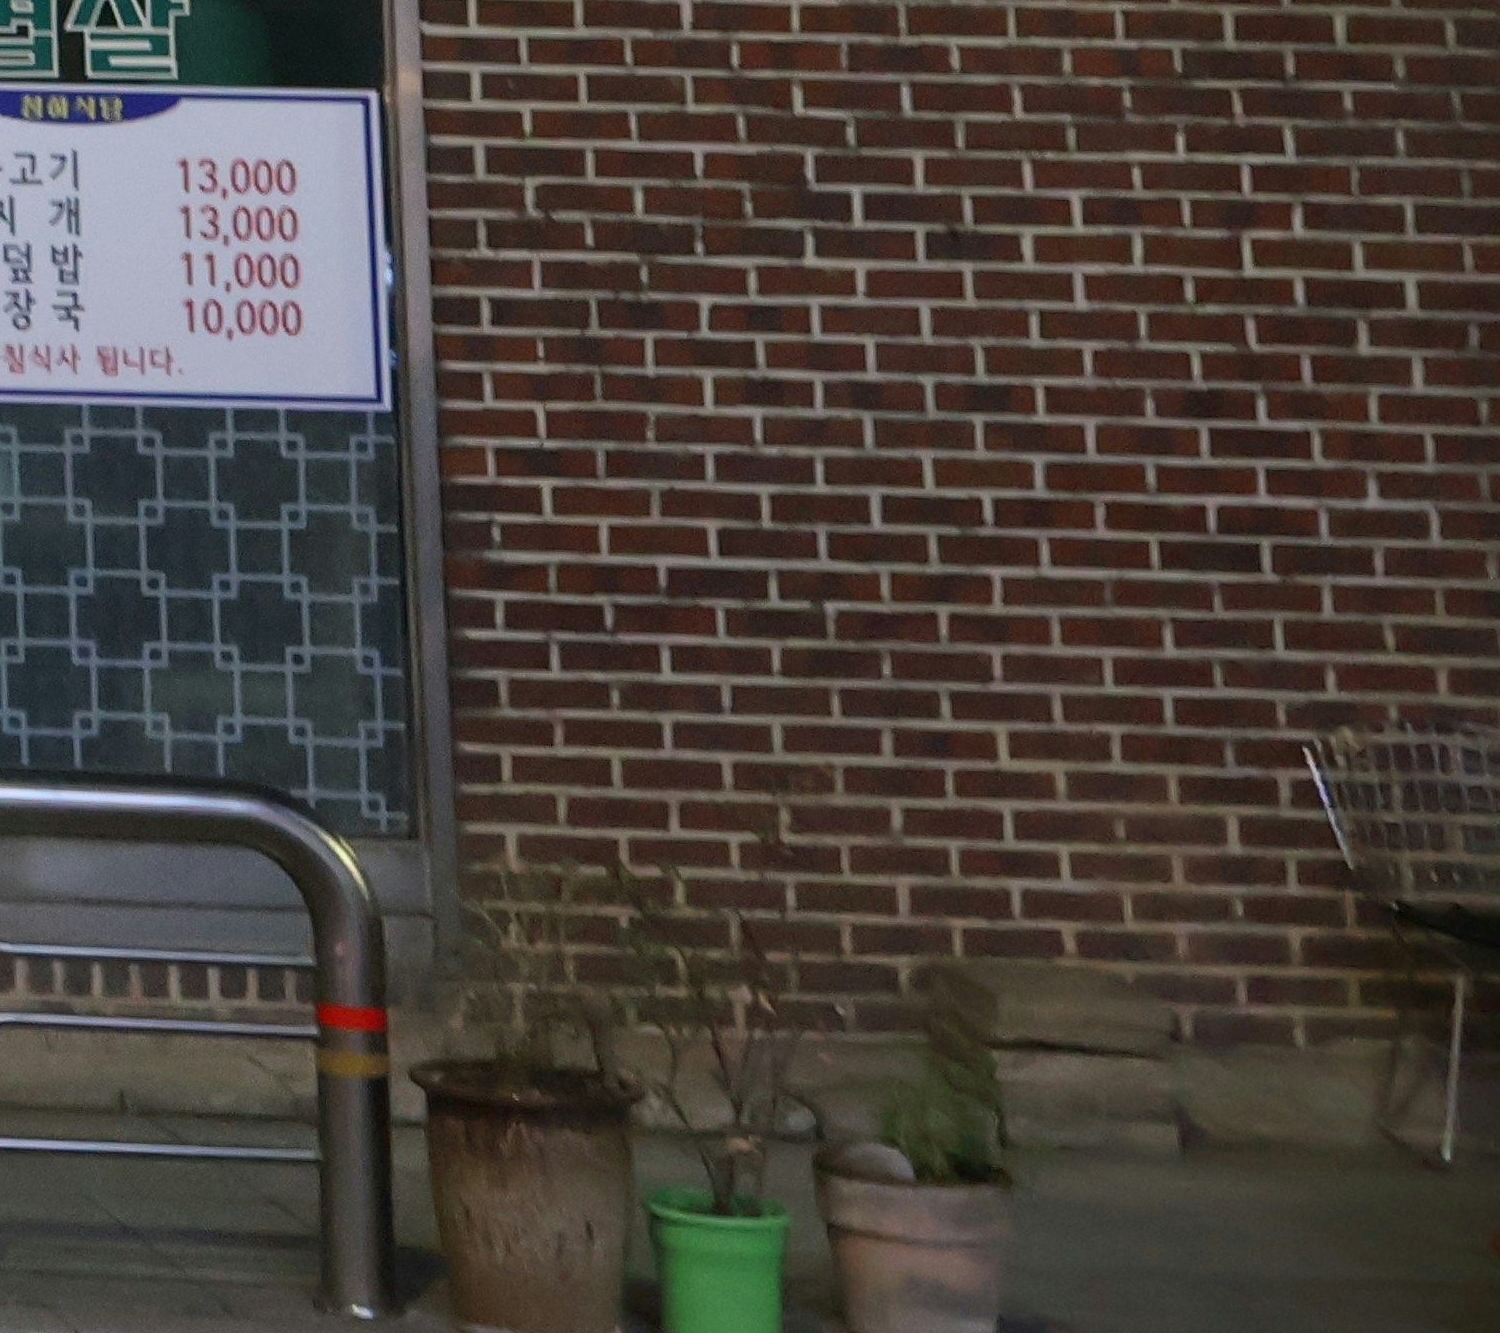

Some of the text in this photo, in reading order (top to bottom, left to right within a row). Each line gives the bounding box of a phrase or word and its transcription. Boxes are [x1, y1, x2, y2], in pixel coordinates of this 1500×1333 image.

[179, 159, 296, 199] 13,000
[181, 206, 298, 245] 13,000
[183, 253, 300, 292] 11,000
[185, 299, 301, 340] 10,000
[97, 347, 184, 376] 됩니다.
